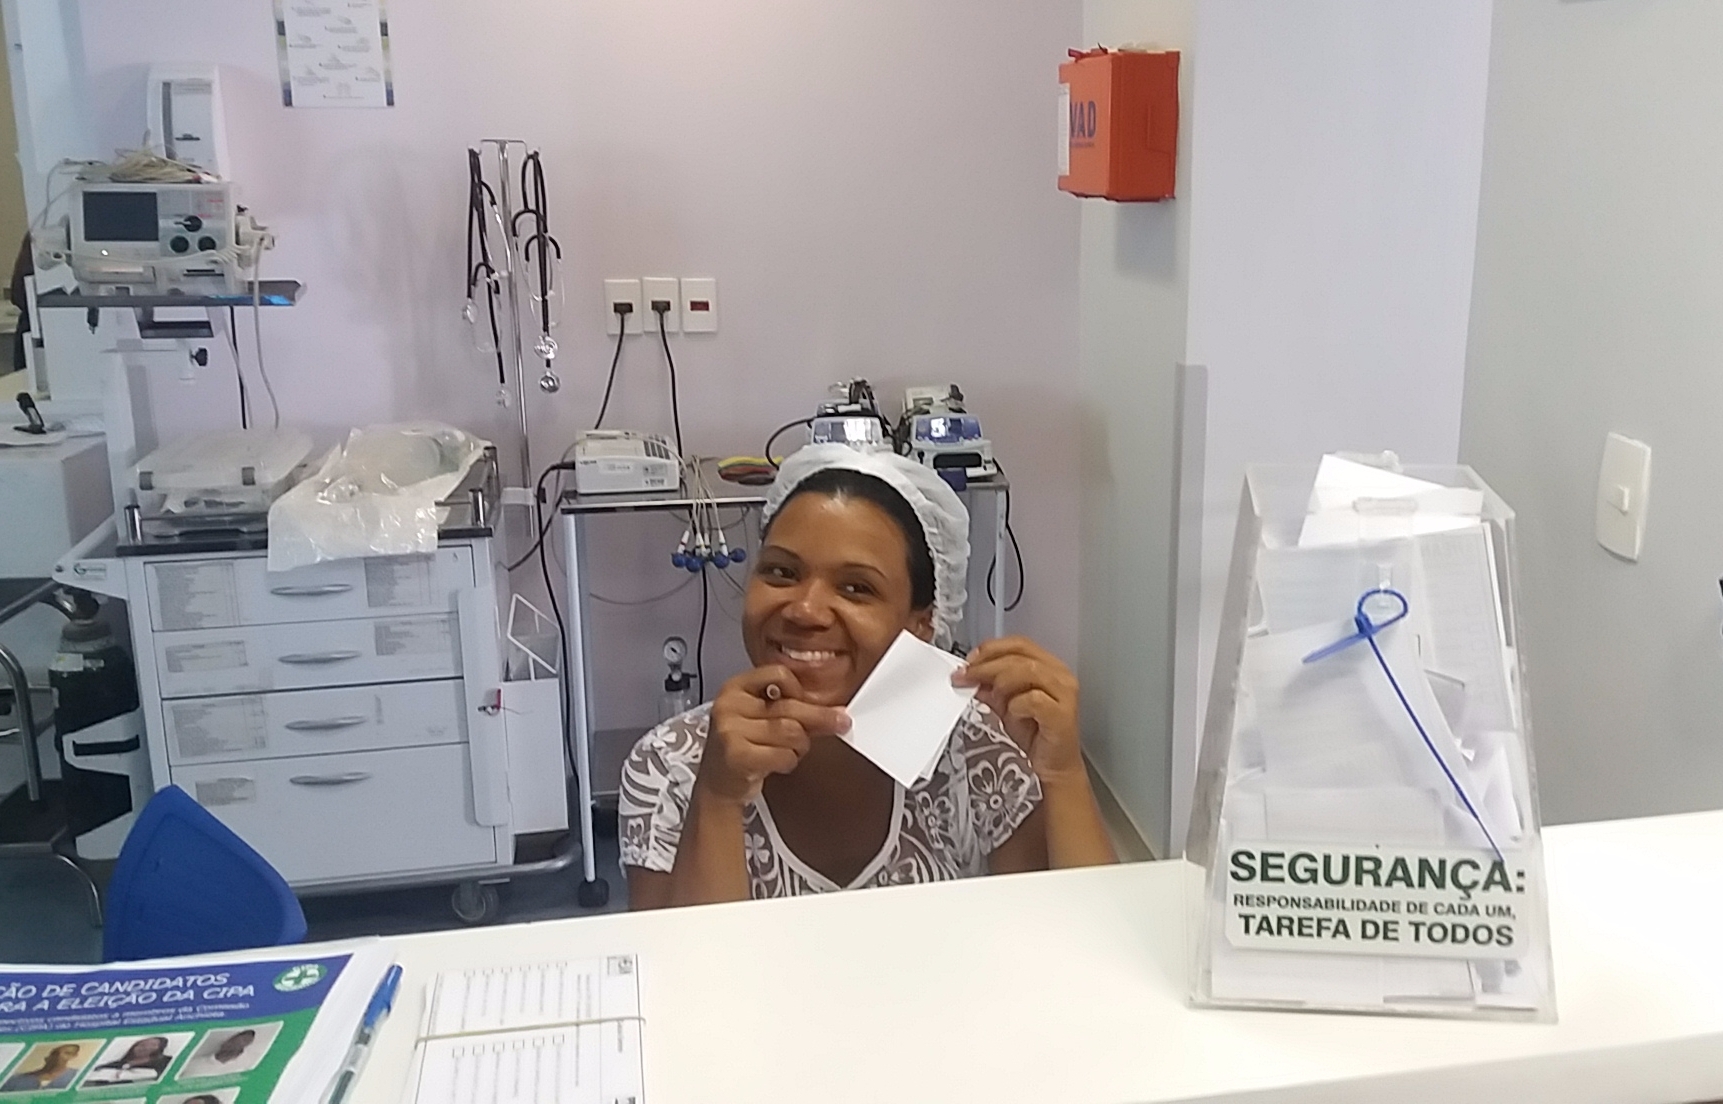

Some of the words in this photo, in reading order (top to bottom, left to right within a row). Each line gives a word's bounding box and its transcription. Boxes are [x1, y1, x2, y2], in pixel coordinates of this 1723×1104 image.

[1229, 849, 1526, 900] SEGURANÇA:
[1233, 894, 1401, 914] RESPONSABILIDADE
[1406, 900, 1428, 915] DE
[1434, 902, 1479, 918] CADA
[1485, 905, 1516, 920] UM,
[1238, 914, 1351, 940] TAREFA
[1361, 918, 1400, 942] DE
[1408, 921, 1514, 947] TODOS
[33, 999, 49, 1011] A
[57, 990, 157, 1010] ELEIÇÃO
[162, 989, 195, 1003] DA
[203, 985, 254, 1000] CIPA
[42, 983, 76, 998] DE
[81, 972, 230, 996] CANDIDATOS
